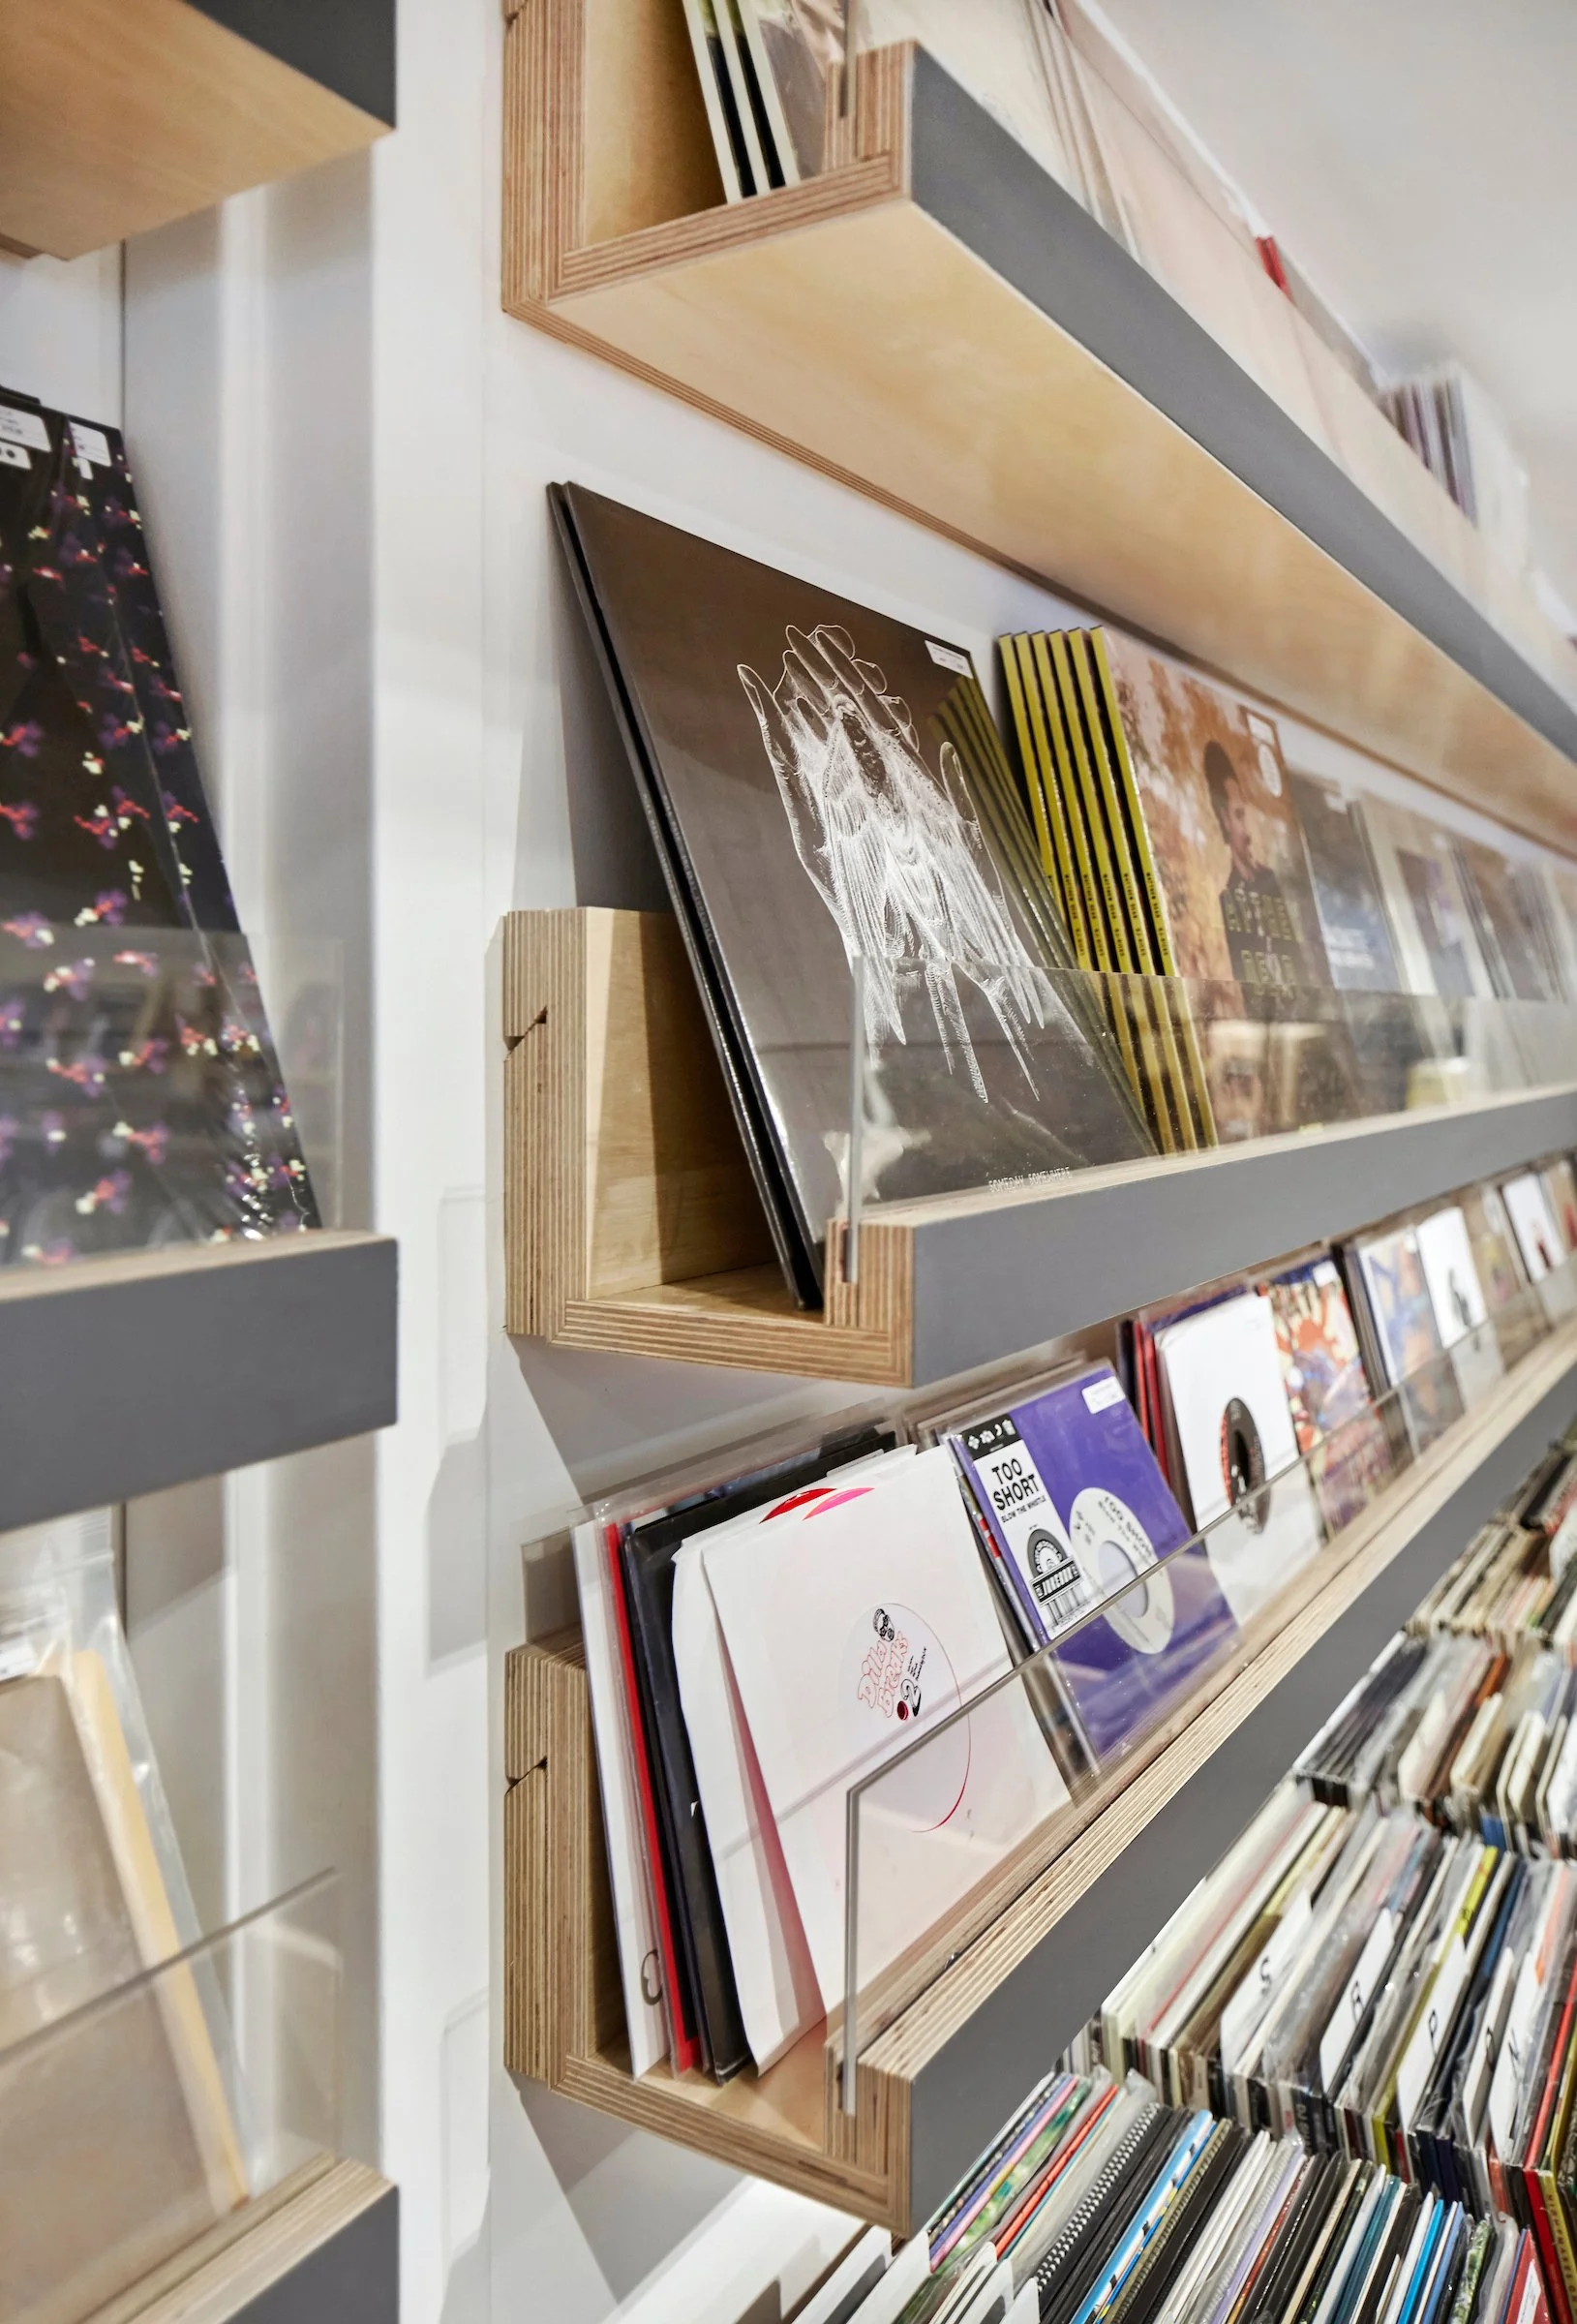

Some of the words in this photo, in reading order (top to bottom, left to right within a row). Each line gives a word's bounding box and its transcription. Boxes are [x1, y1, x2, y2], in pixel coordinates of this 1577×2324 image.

[991, 1457, 1023, 1484] TOO
[993, 1474, 1039, 1511] SHORT
[1001, 1511, 1016, 1523] BLOW
[1016, 1504, 1028, 1514] THE
[857, 1639, 887, 1709] Dilla
[900, 1678, 922, 1717] 2
